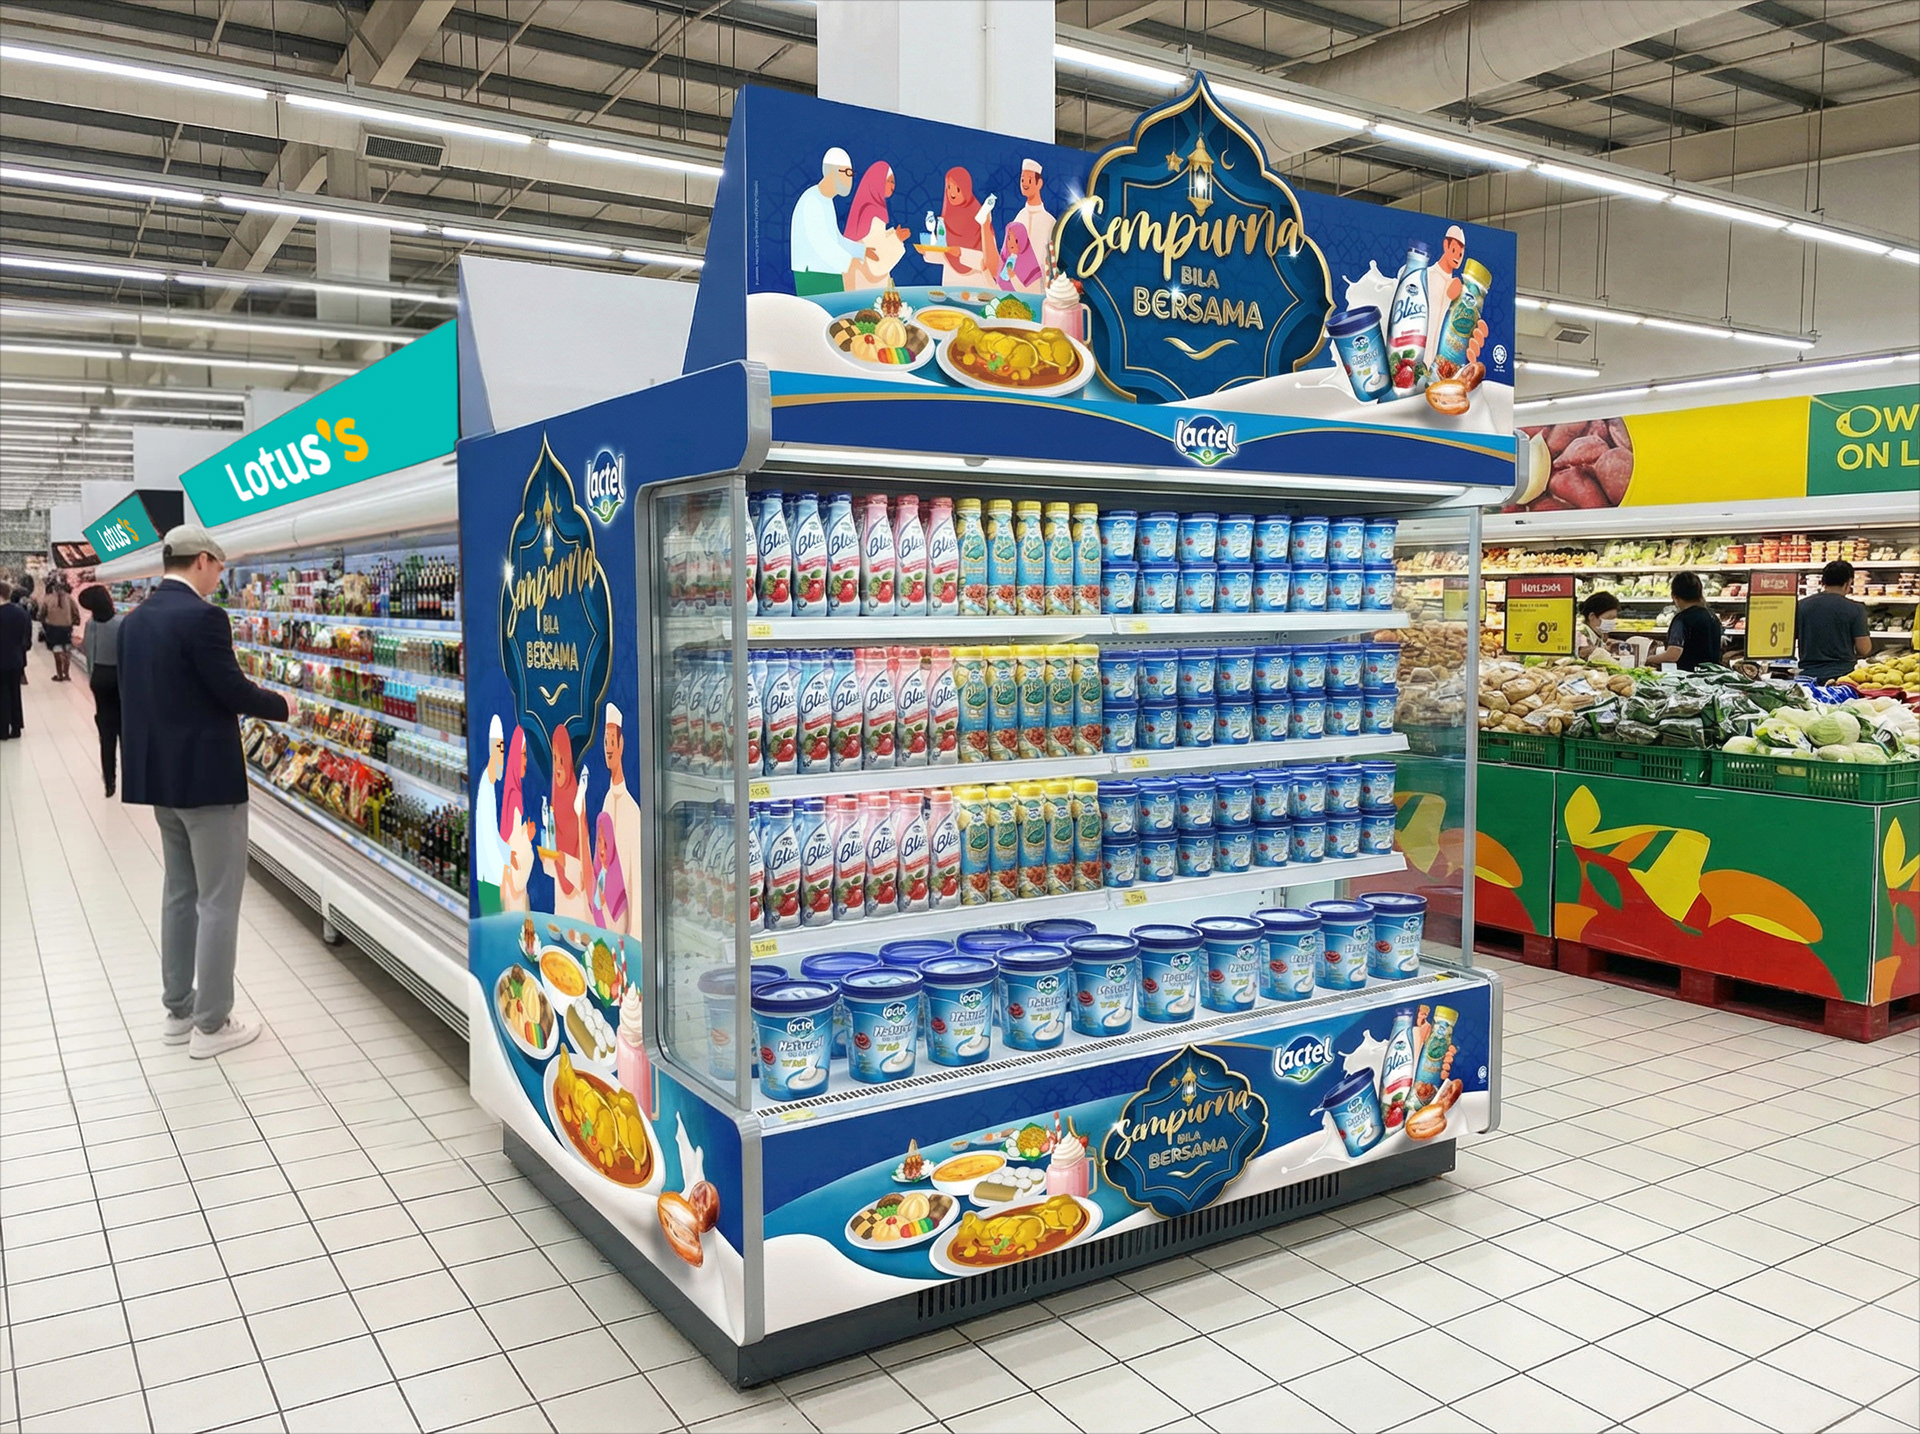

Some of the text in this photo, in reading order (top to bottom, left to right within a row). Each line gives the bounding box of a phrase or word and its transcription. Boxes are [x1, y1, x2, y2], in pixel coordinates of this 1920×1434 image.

[1055, 195, 1304, 280] Sempurna
[1180, 265, 1220, 290] BILA
[1133, 286, 1264, 331] BERSAMA
[1175, 418, 1239, 457] lactel
[1837, 441, 1890, 471] ON
[225, 417, 369, 502] Lotus's
[587, 453, 625, 508] lactel
[96, 517, 139, 552] Lotus's
[526, 641, 579, 672] BERSAMA
[1273, 1036, 1336, 1078] lactel
[1113, 1088, 1253, 1161] Sempurna
[1148, 1136, 1229, 1170] BERSAMA
